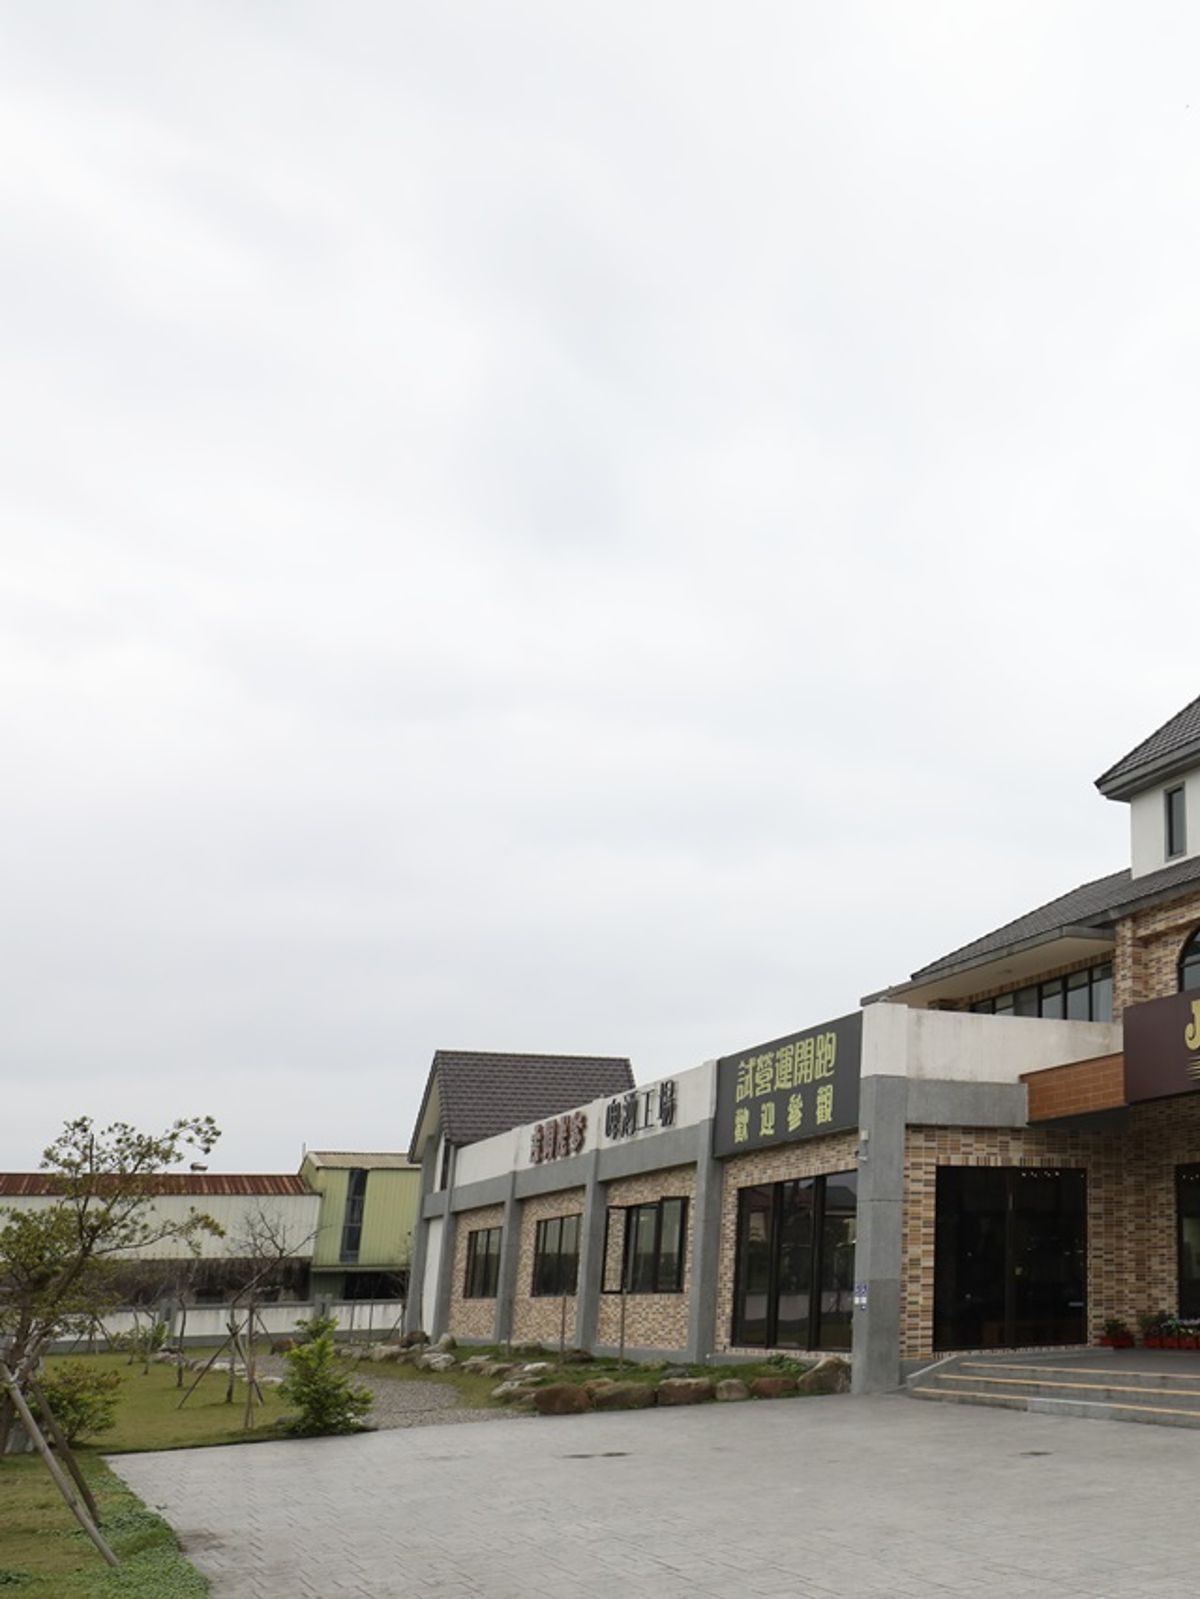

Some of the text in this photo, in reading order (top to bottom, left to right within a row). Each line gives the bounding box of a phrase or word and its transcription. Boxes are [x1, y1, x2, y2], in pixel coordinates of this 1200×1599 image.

[736, 1032, 836, 1102] 試營運開跑
[734, 1085, 833, 1143] 歡迎參觀
